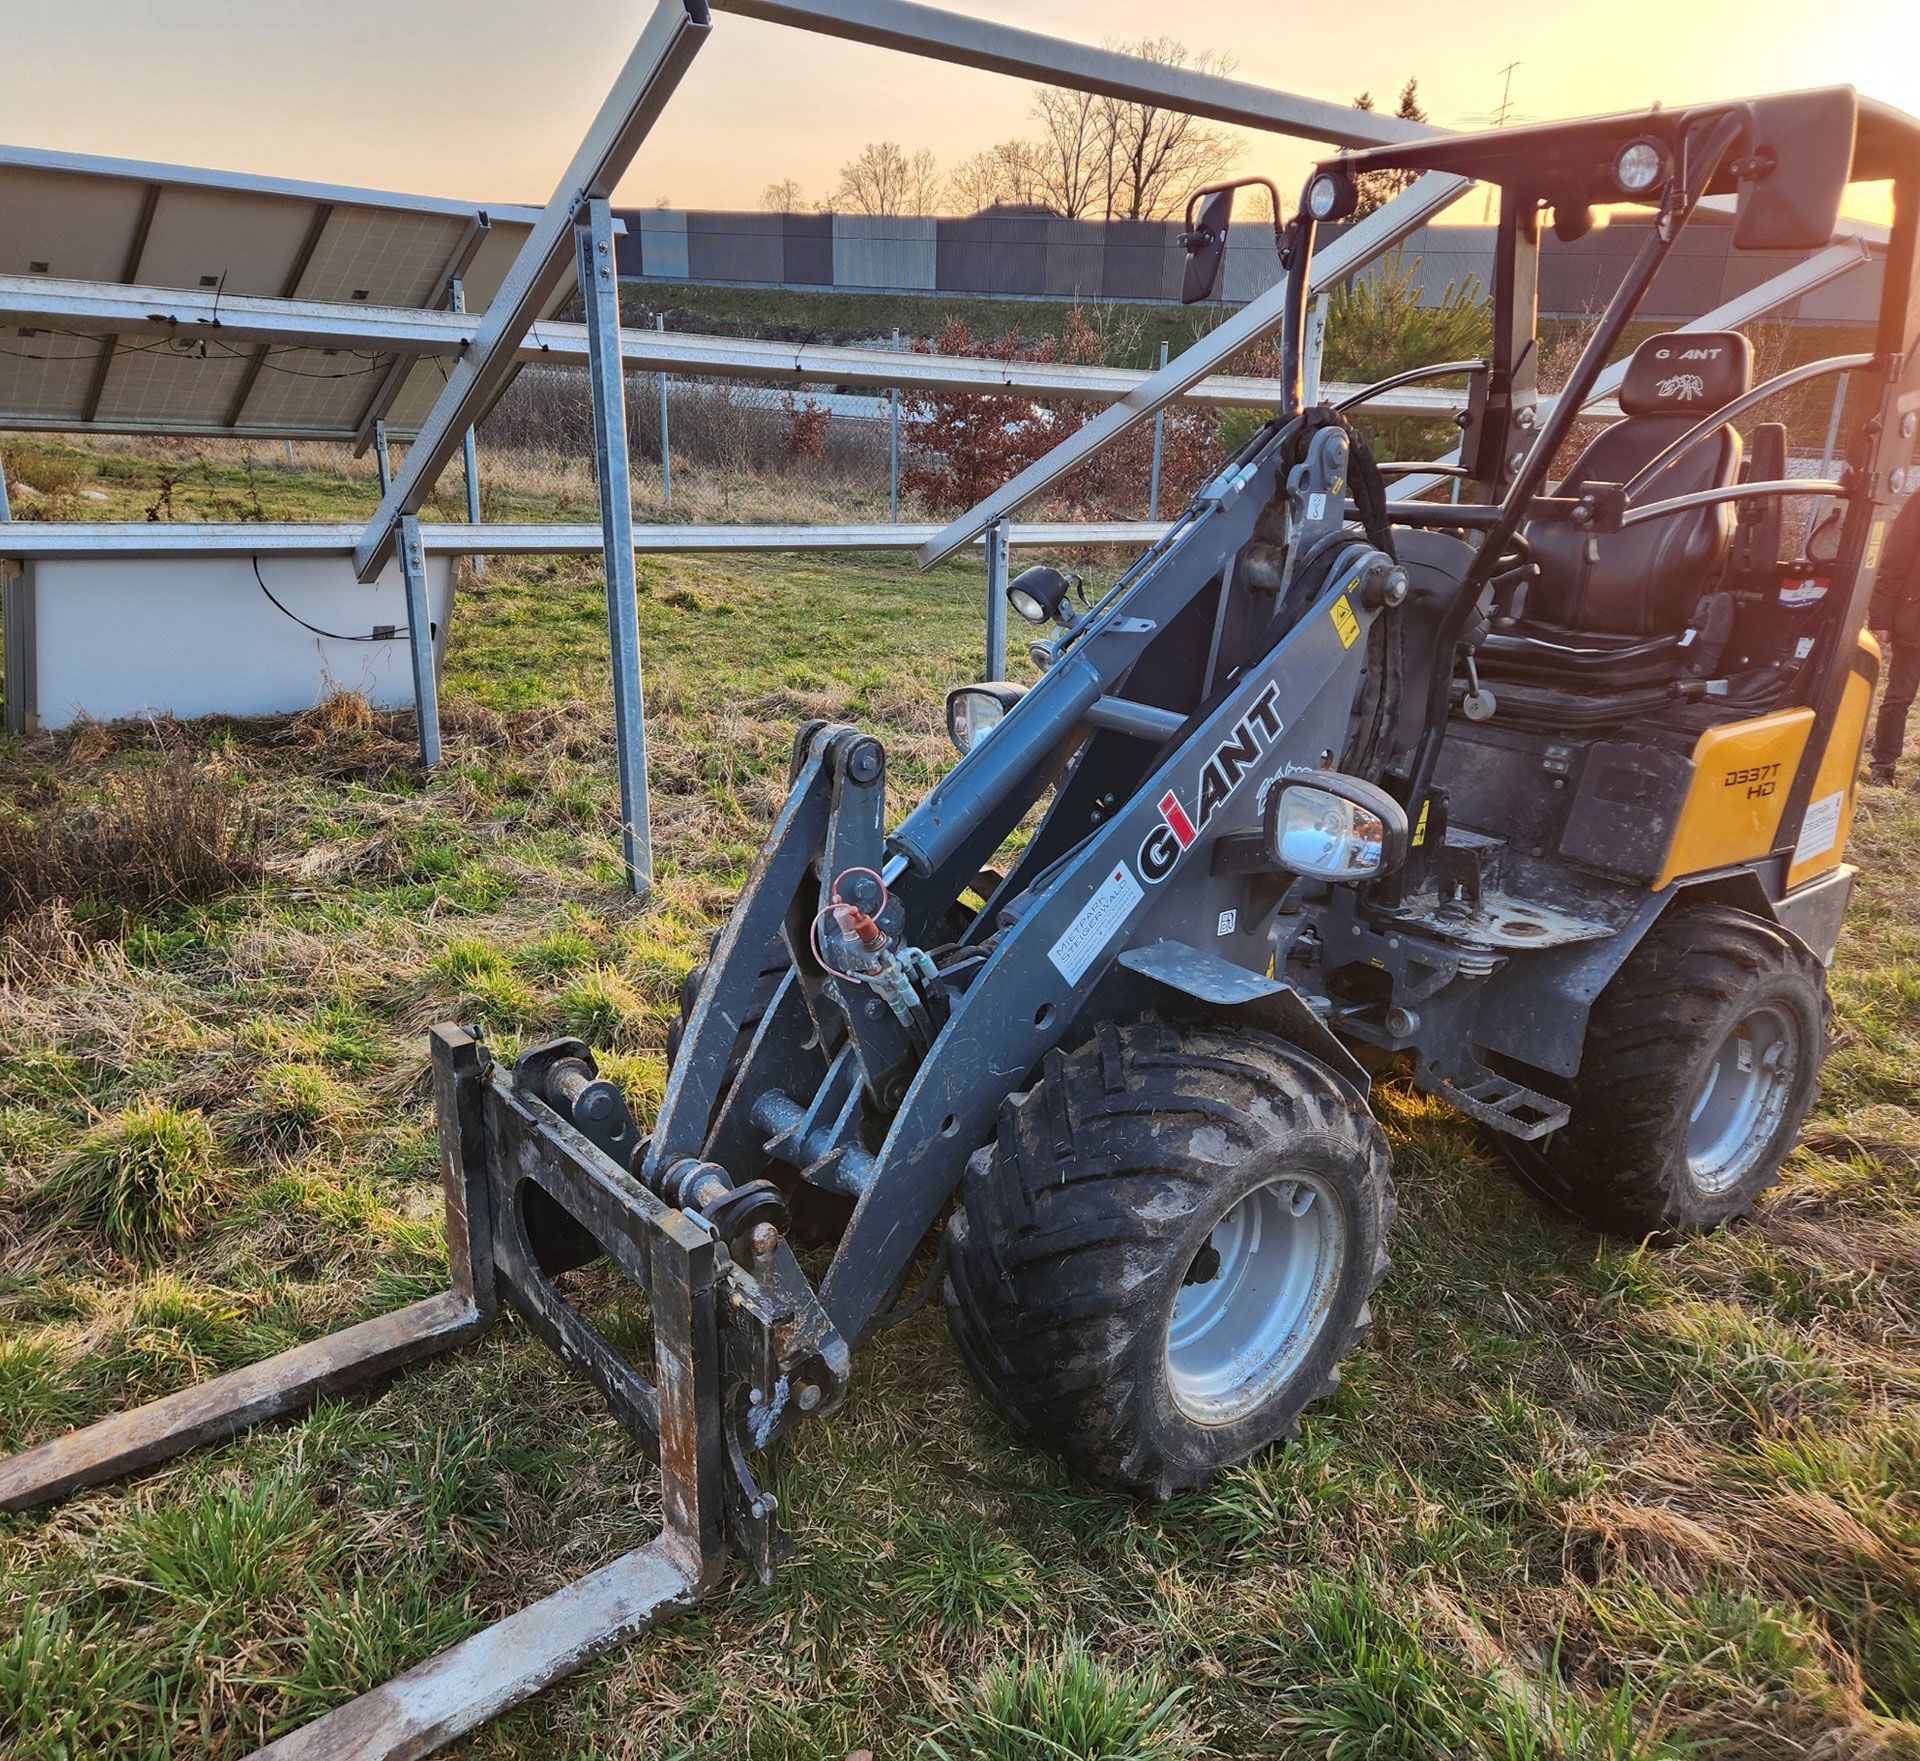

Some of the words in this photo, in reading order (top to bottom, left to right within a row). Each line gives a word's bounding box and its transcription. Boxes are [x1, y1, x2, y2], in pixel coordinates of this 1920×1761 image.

[1655, 348, 1722, 360] GANT
[1724, 763, 1781, 787] D337T
[1747, 781, 1776, 800] HD
[1056, 893, 1107, 957] MIETPARK
[1061, 879, 1128, 964] STEIGERWALD
